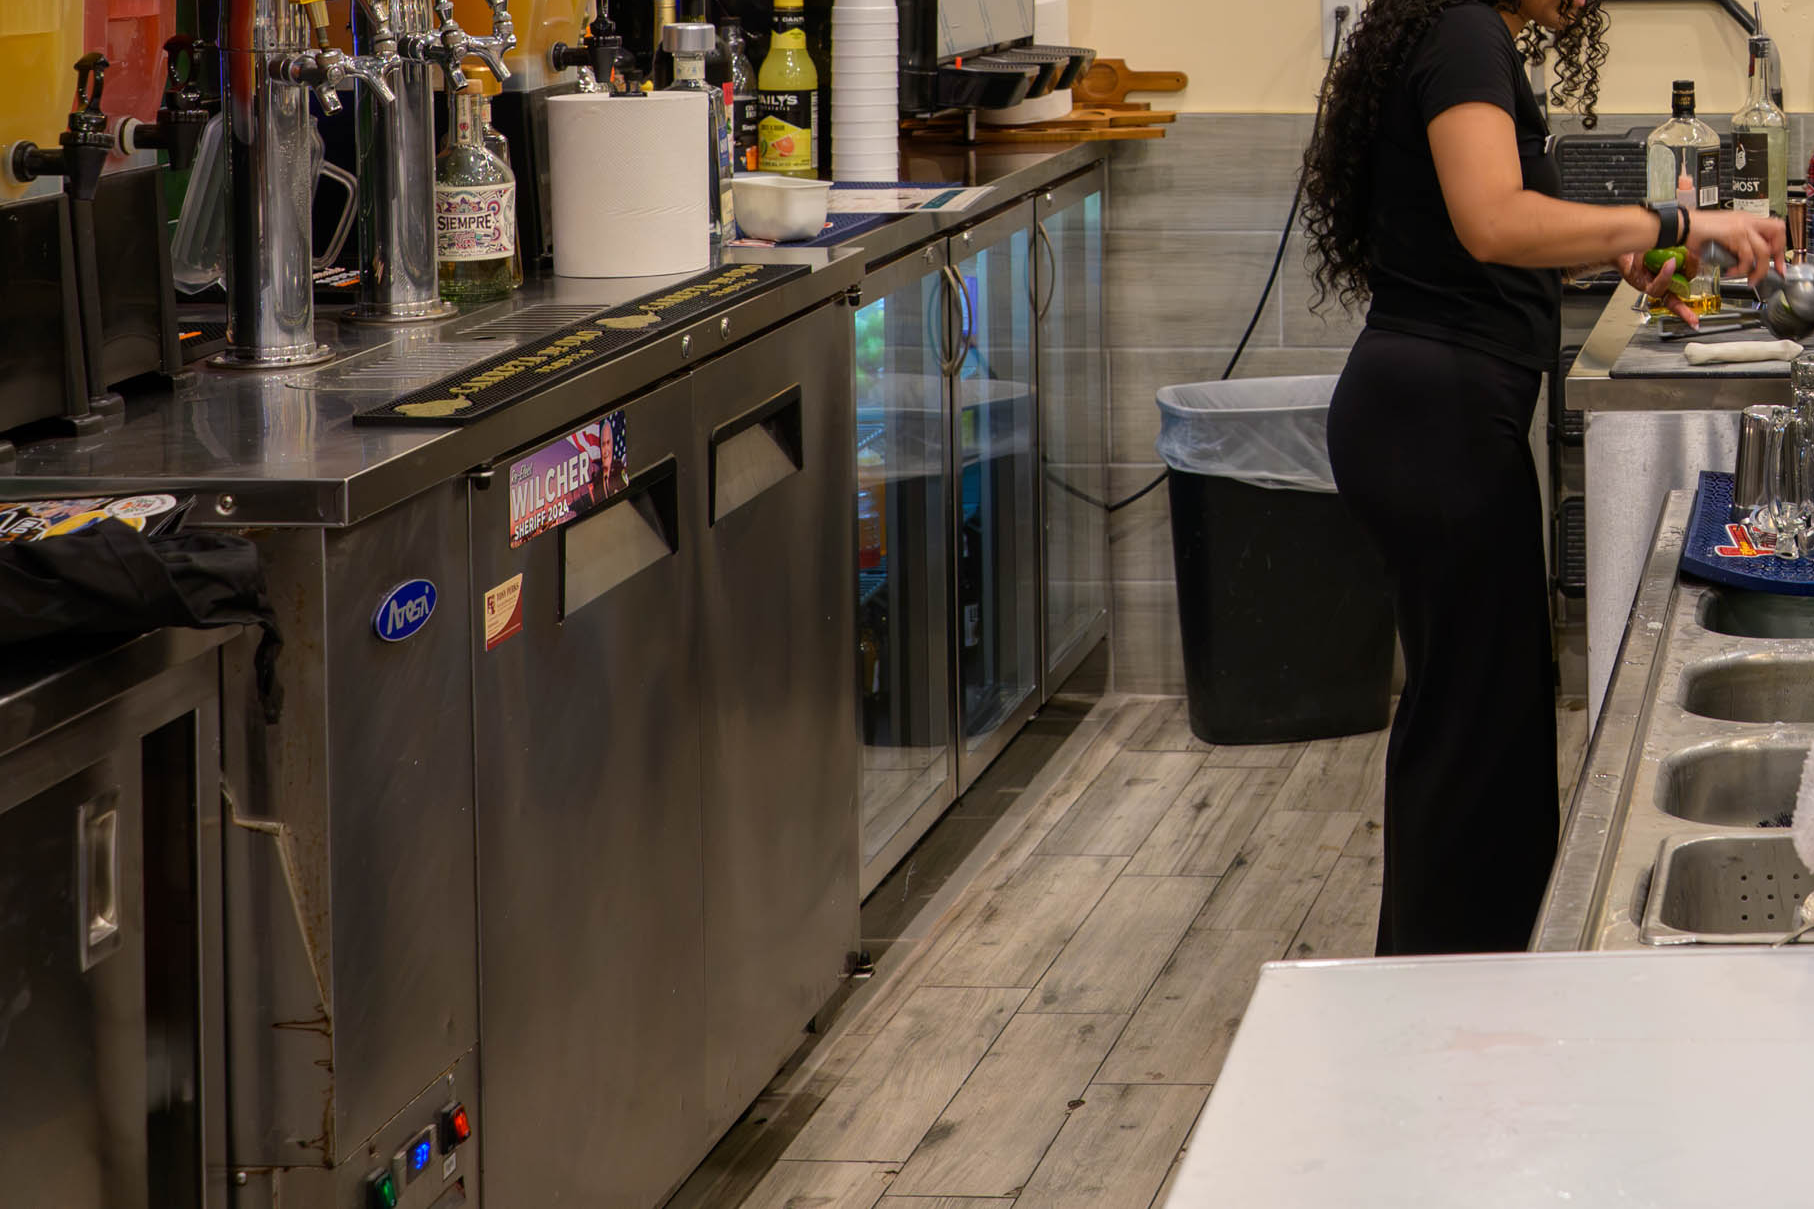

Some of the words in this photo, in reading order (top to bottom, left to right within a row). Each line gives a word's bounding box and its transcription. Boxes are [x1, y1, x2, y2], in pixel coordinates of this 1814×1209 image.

[437, 213, 492, 231] SIEMPRE
[511, 451, 590, 522] WILCHER
[514, 511, 547, 541] SHERIFF
[547, 501, 570, 522] 2024
